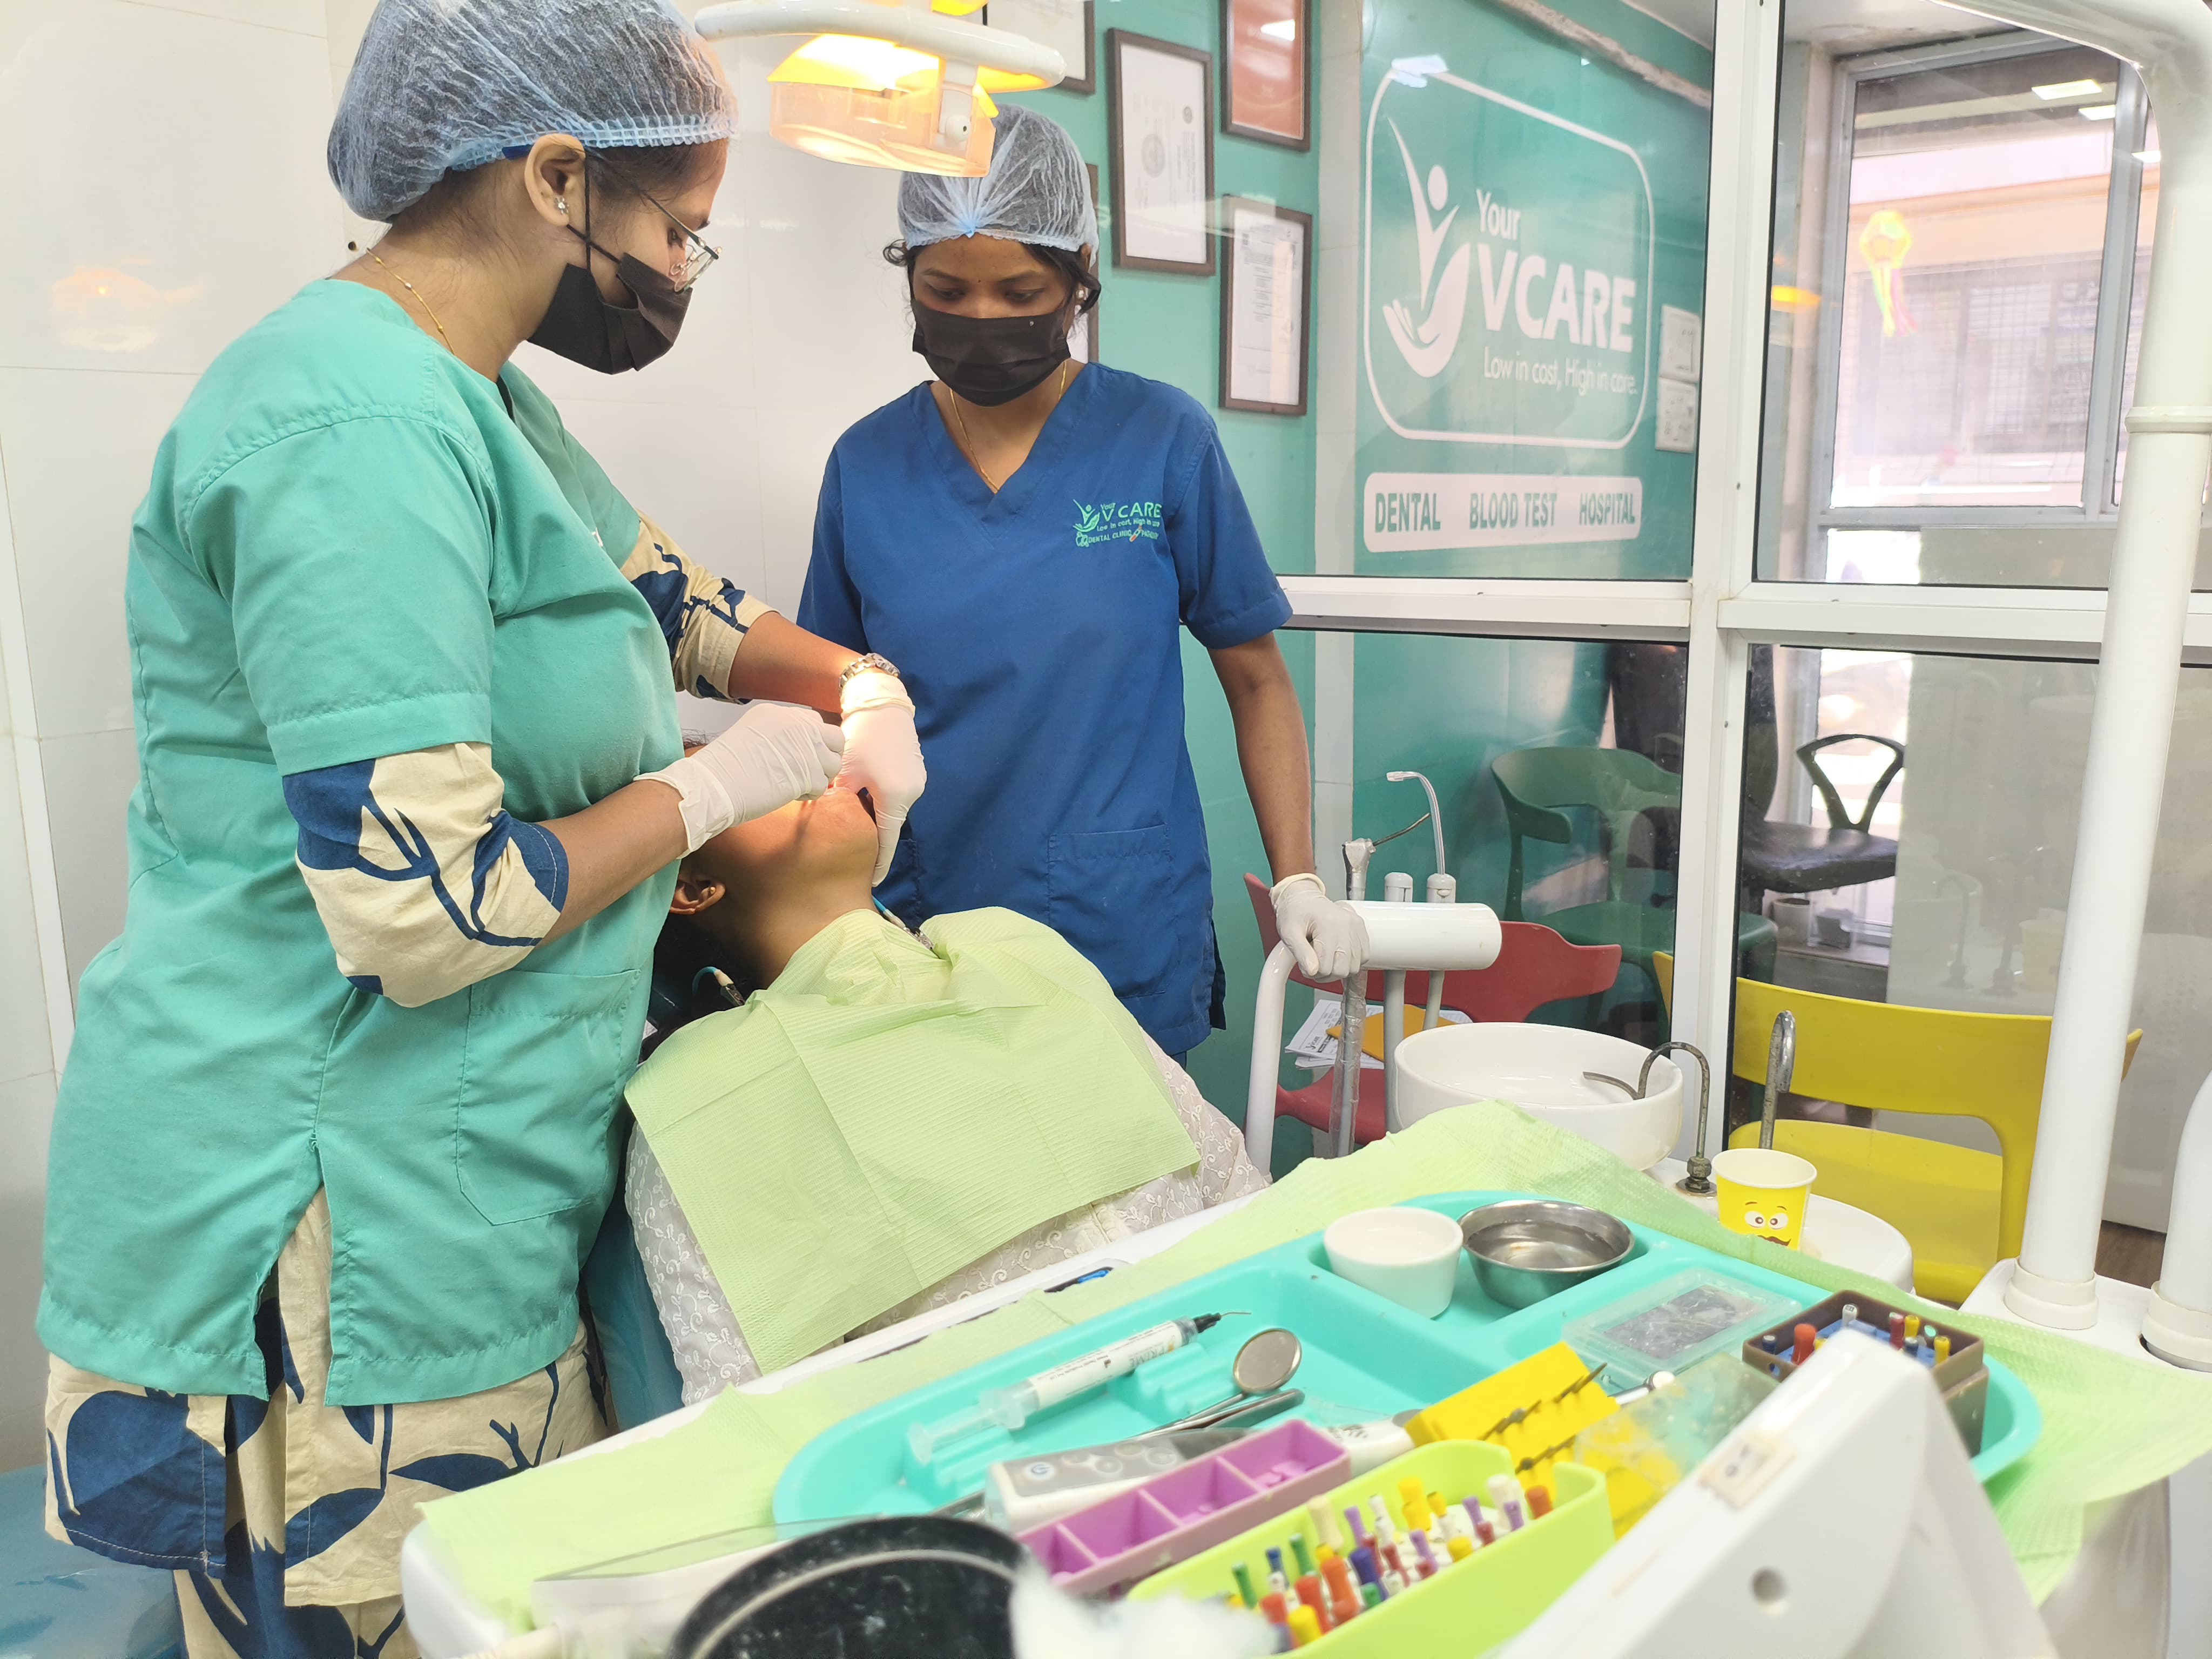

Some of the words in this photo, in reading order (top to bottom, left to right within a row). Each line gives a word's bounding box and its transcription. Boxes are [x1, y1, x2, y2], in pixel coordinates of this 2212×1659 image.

[1476, 188, 1521, 241] Your
[1478, 243, 1636, 353] VCARE
[1485, 346, 1513, 379] Low
[1516, 350, 1528, 381] in
[1532, 359, 1562, 392] cost,
[1565, 357, 1594, 396] High
[1597, 362, 1608, 391] in
[1100, 502, 1116, 511] Your
[1375, 492, 1441, 533] DENTAL
[1469, 492, 1519, 529] BLOOD
[1525, 492, 1558, 527] TEST
[1579, 492, 1635, 526] HOSPITAL
[1088, 534, 1110, 543] DENTAL
[1112, 529, 1132, 538] CLINIC
